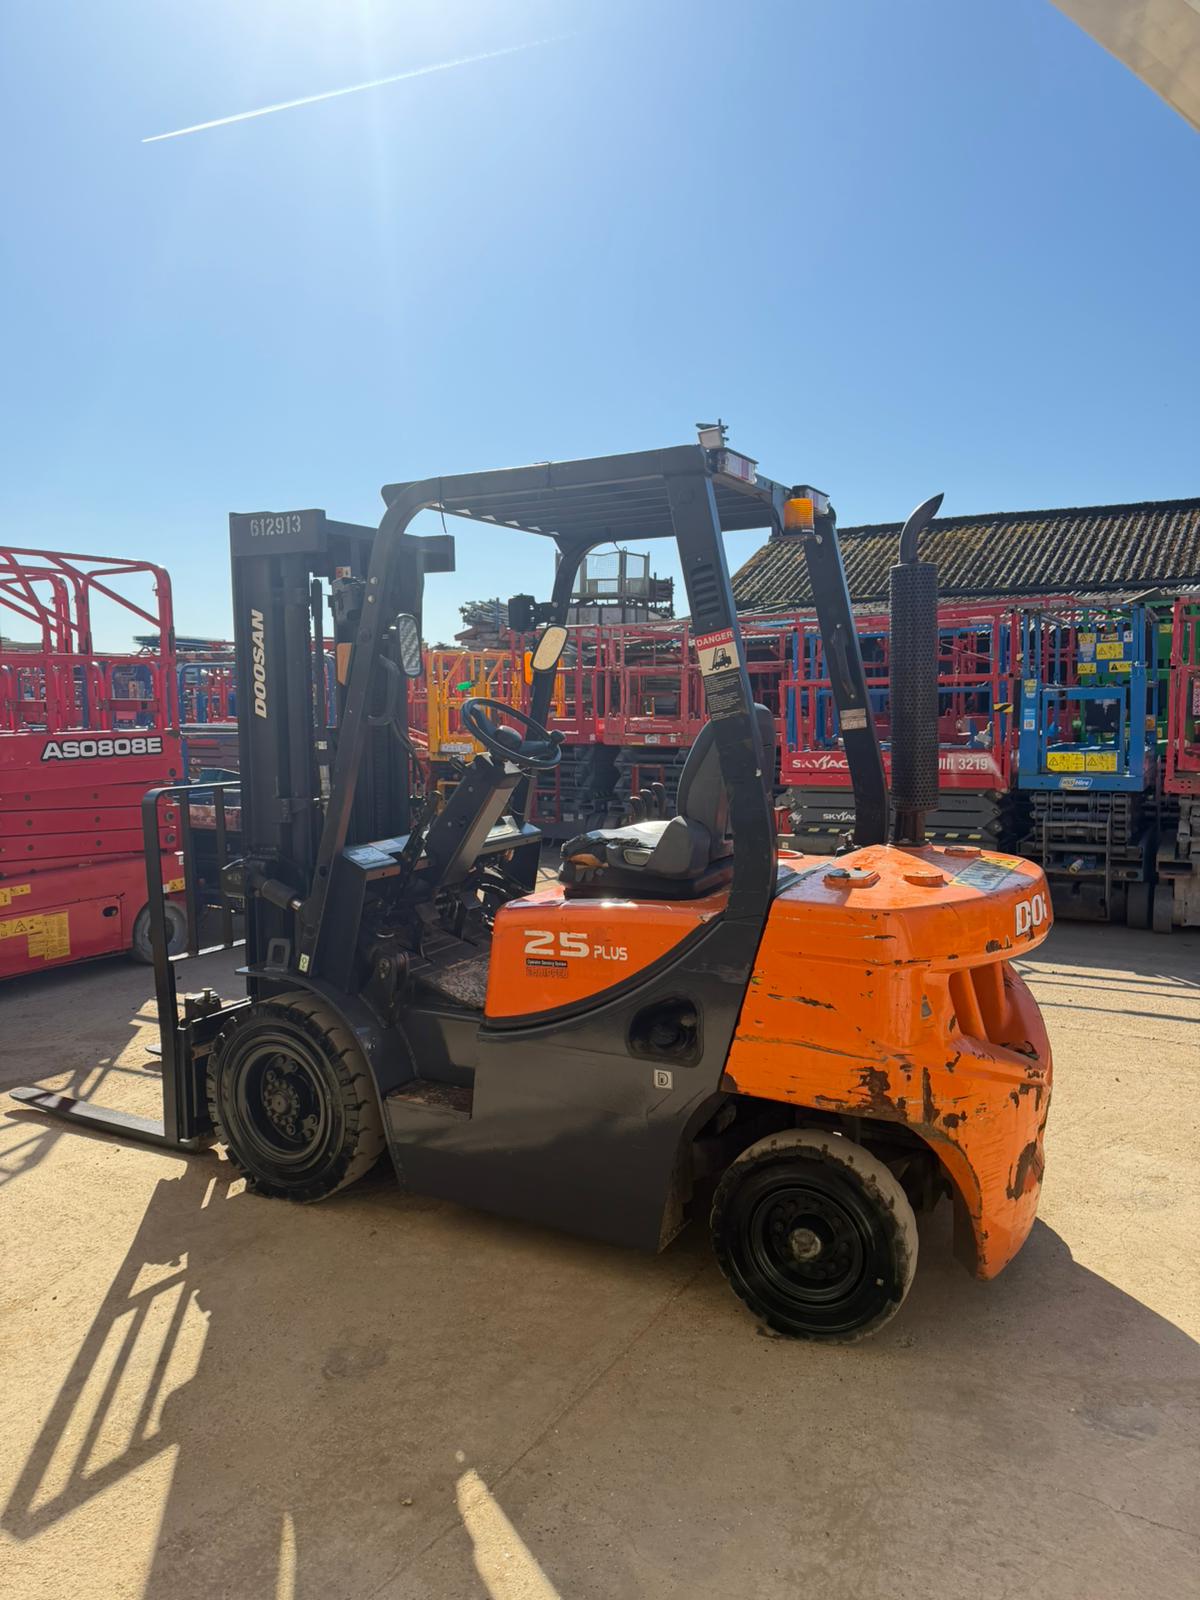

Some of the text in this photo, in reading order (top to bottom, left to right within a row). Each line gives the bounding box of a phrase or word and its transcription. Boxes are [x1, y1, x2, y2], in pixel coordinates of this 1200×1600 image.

[250, 514, 301, 537] 612913
[696, 630, 734, 647] DANGER
[251, 608, 267, 719] DOOSAN
[41, 736, 162, 761] AS0808E
[792, 754, 849, 770] SKYJAC
[958, 757, 988, 770] 3219
[823, 811, 856, 822] SKYJAC
[1016, 892, 1047, 937] DO
[524, 930, 628, 961] 25 PLUS
